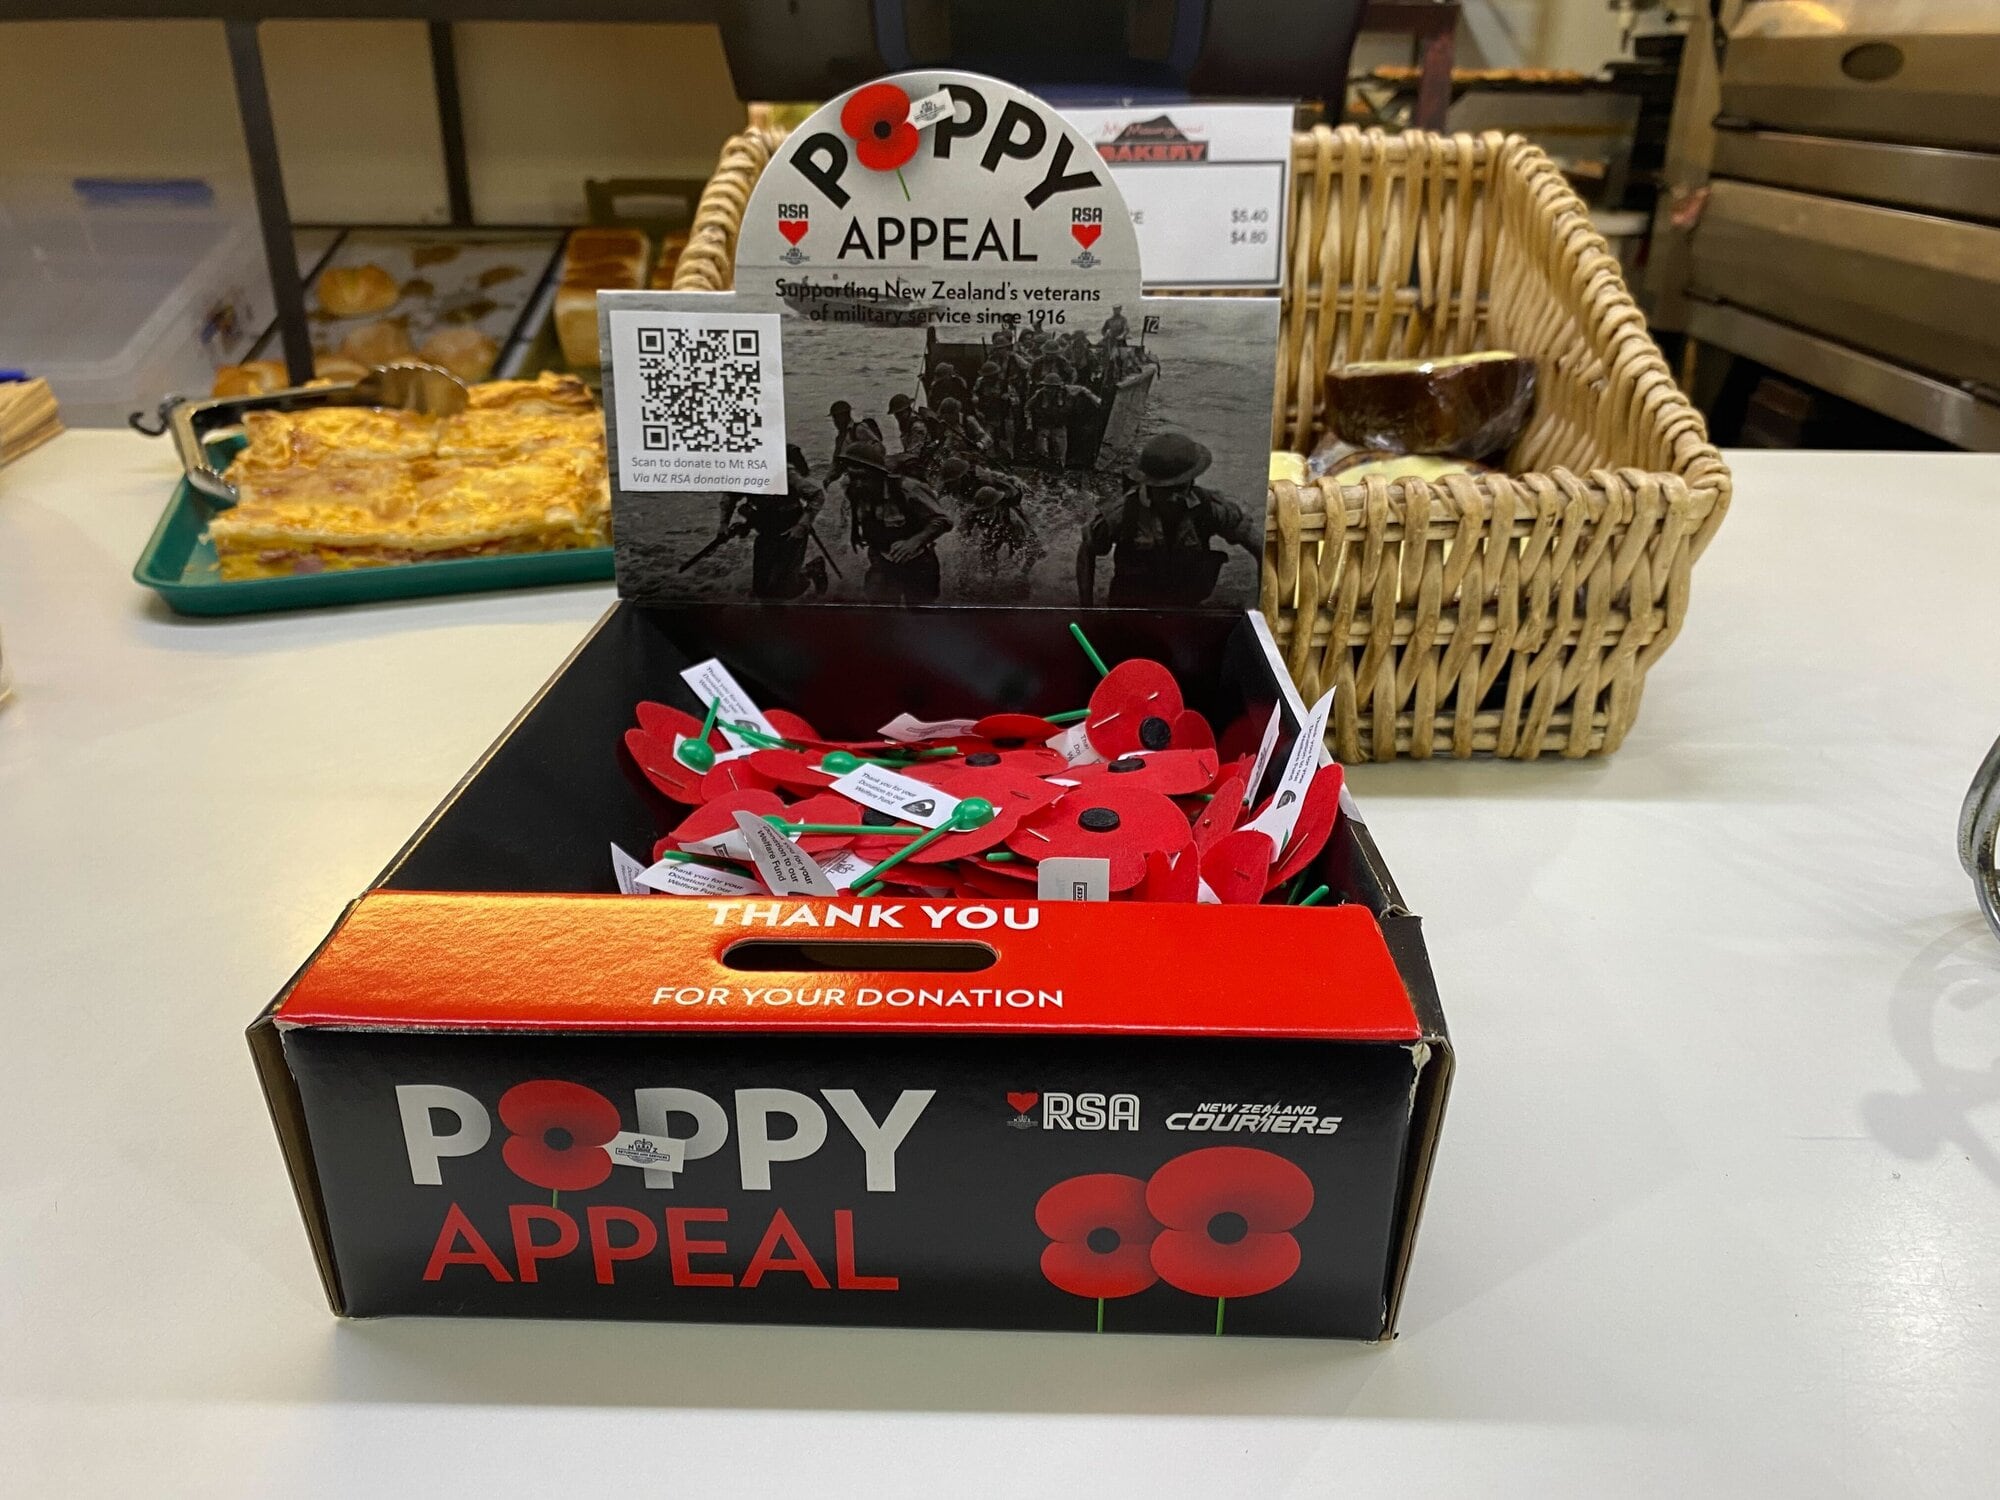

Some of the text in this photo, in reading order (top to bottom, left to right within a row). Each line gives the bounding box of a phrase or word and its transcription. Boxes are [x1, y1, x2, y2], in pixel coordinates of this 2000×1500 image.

[1098, 144, 1205, 161] BAKERY
[778, 203, 809, 219] RSA
[1072, 207, 1103, 223] RSA
[837, 215, 1038, 262] APPEAL
[1230, 230, 1269, 245] $4.80
[775, 278, 1101, 302] Supporting New Zealand's veterans
[810, 303, 1066, 326] of military service since 1916
[631, 457, 768, 470] Scan to donate to Mt RSA
[632, 473, 770, 487] Via NZ RSA donation page
[855, 785, 895, 806] Welfare Fund
[858, 779, 886, 794] Donation
[893, 793, 907, 801] our
[862, 772, 917, 798] Thank you for your
[757, 829, 776, 860] Welfare
[772, 859, 787, 882] Fund
[667, 878, 700, 892] Welfare
[668, 871, 705, 888] Donation
[717, 885, 733, 894] our
[669, 865, 745, 891] Thank you for your
[788, 867, 799, 884] our
[798, 864, 814, 885] your
[707, 902, 1040, 930] THANK YOU
[652, 986, 1064, 1008] FOR YOUR DONATION
[1042, 1091, 1141, 1132] RSA
[1197, 1102, 1317, 1116] NEW ZEALAND
[1165, 1112, 1343, 1135] COURIERS
[422, 1201, 900, 1292] APPEAL
